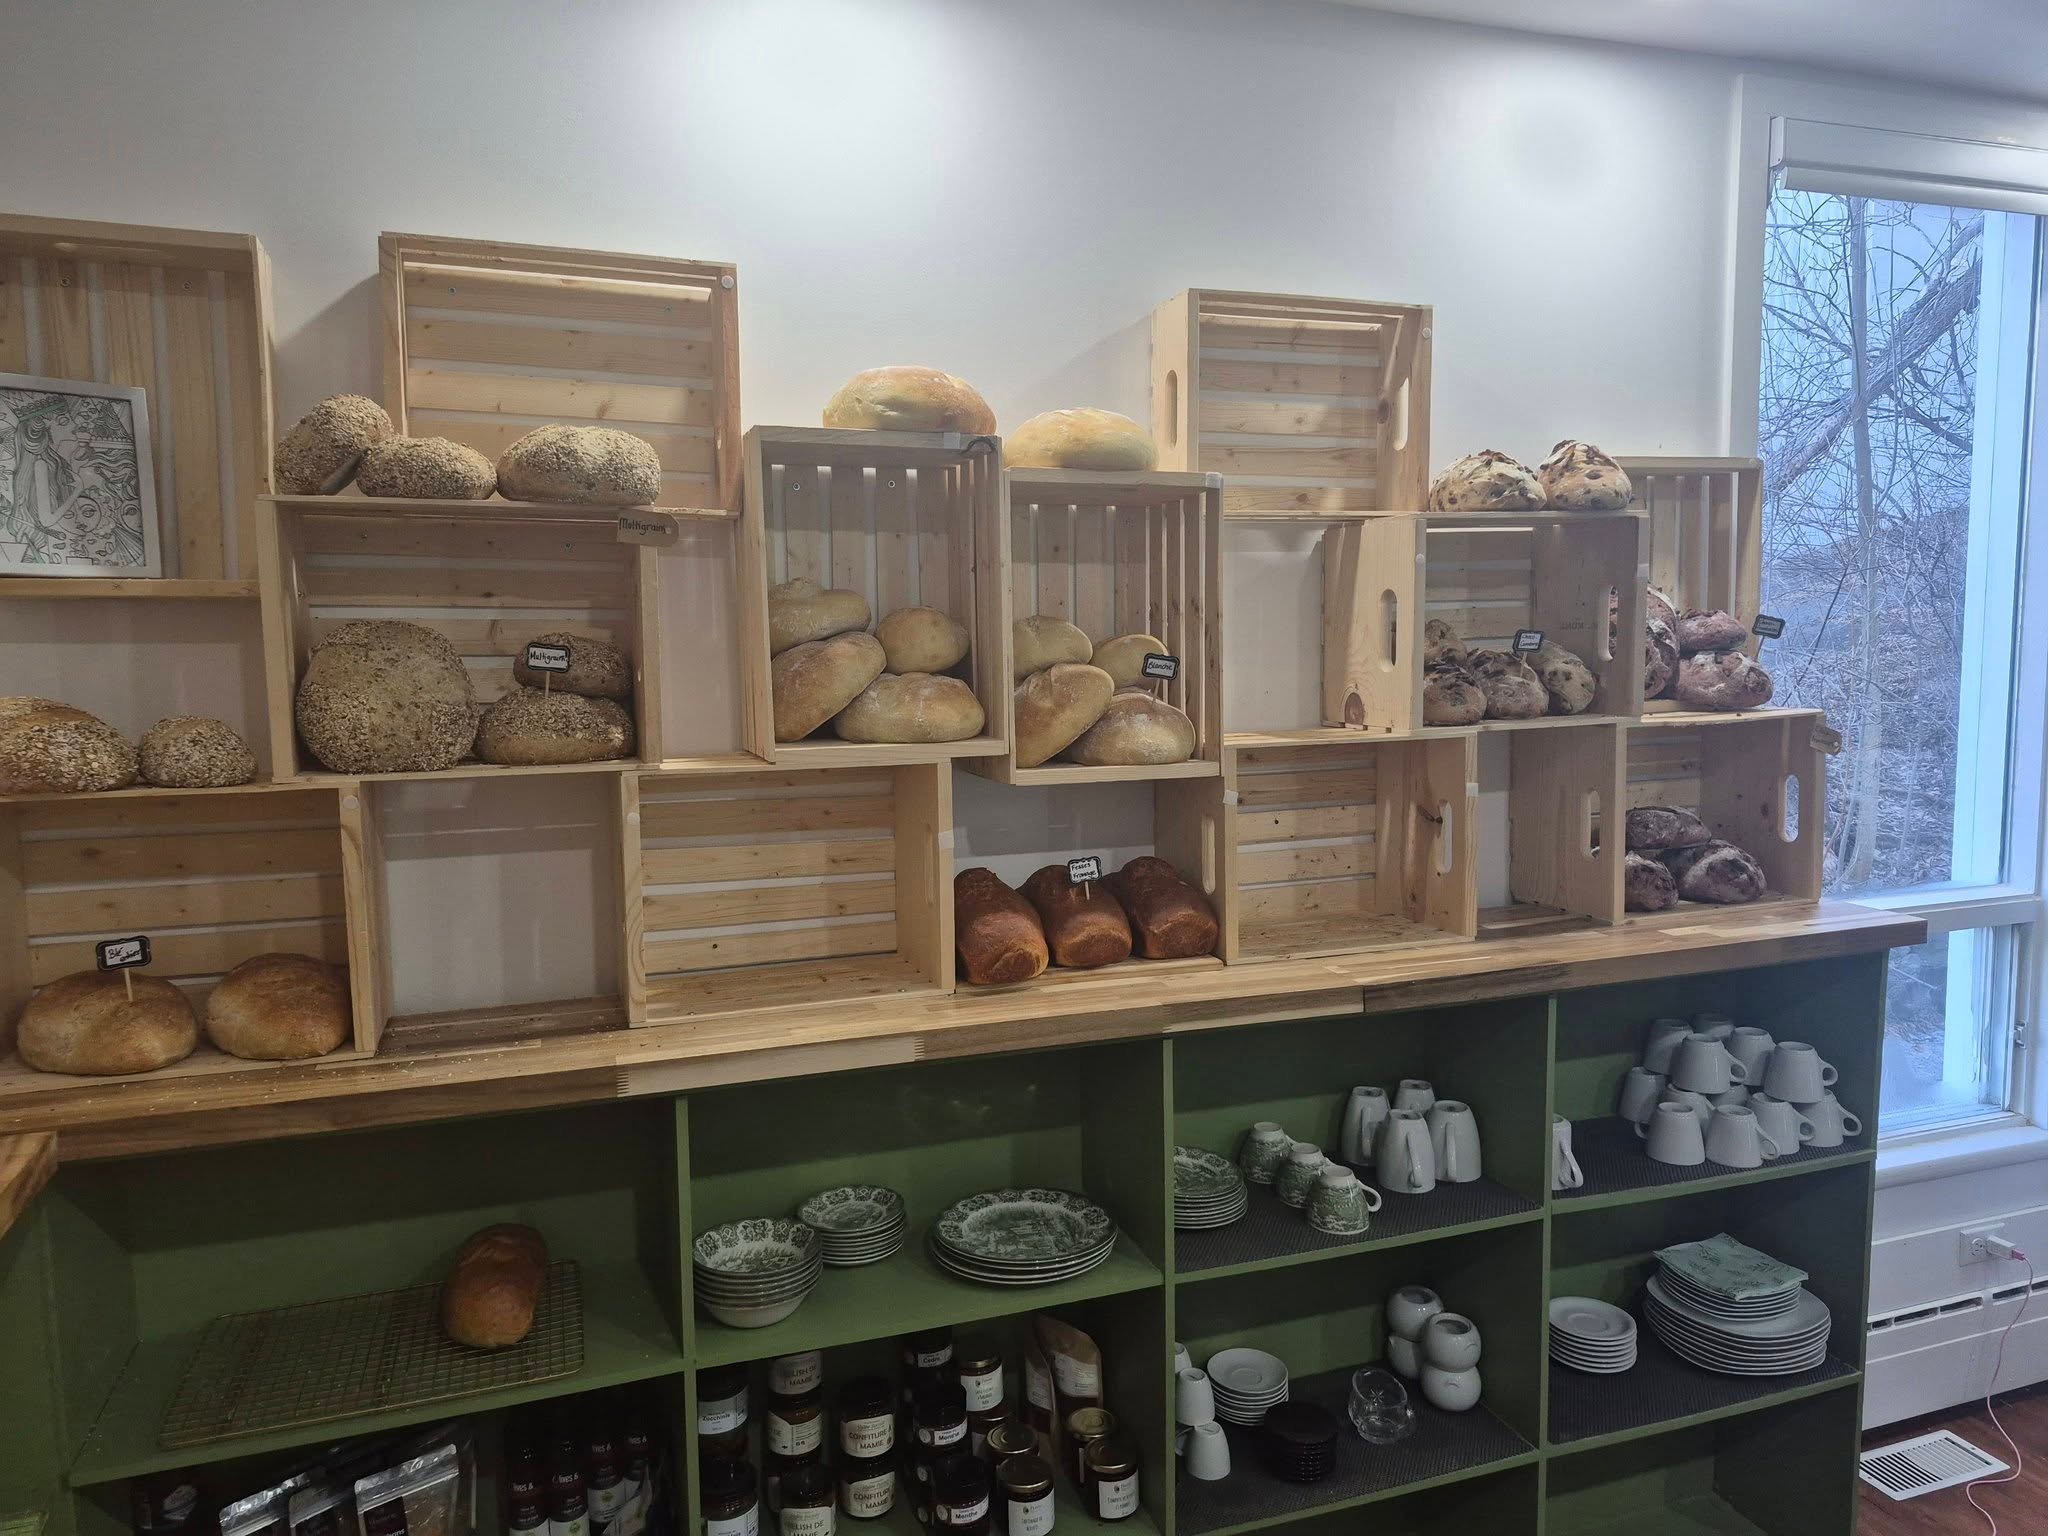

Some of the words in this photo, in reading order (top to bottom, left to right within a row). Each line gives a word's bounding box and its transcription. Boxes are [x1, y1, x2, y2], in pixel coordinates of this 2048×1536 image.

[849, 1429, 887, 1440] CONFITURE
[860, 1440, 883, 1449] MAMIE
[955, 1511, 977, 1519] Menthe
[814, 1520, 824, 1529] DE
